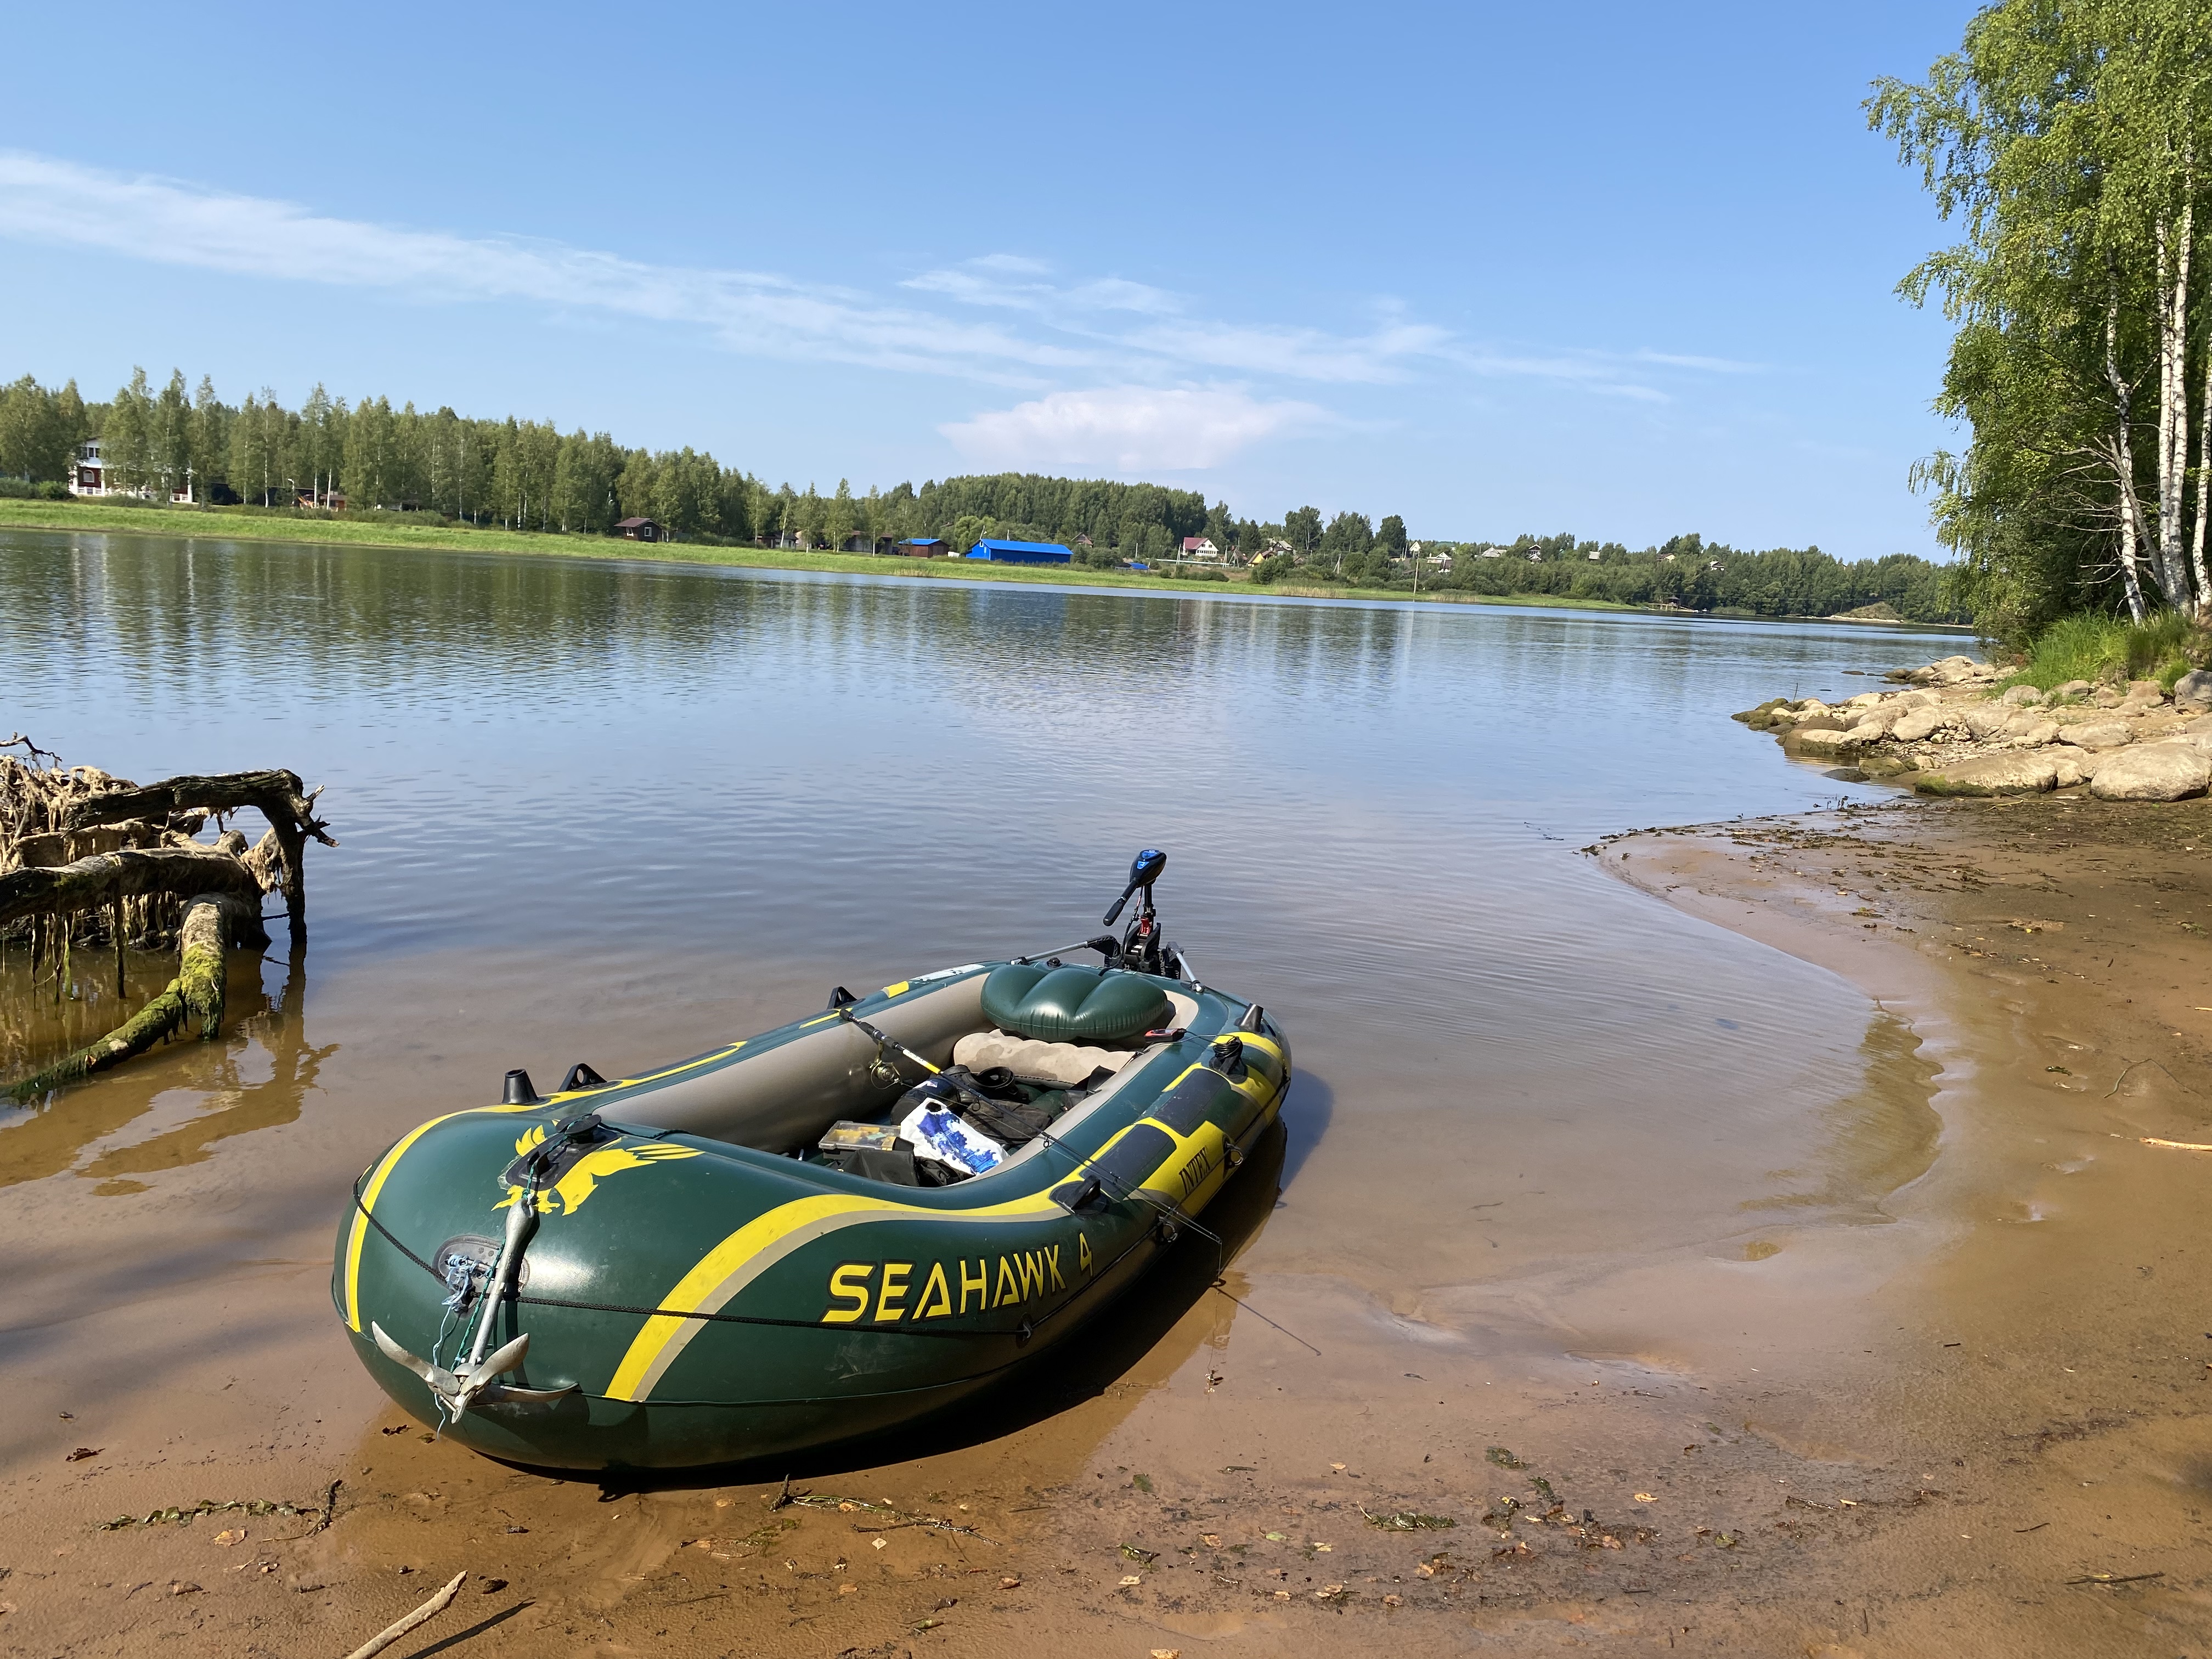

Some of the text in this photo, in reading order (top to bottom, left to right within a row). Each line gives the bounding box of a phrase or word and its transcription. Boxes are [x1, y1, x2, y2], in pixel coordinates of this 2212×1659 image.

[1178, 1145, 1211, 1195] INTEX
[821, 1232, 1093, 1322] SEAHAWK 4
